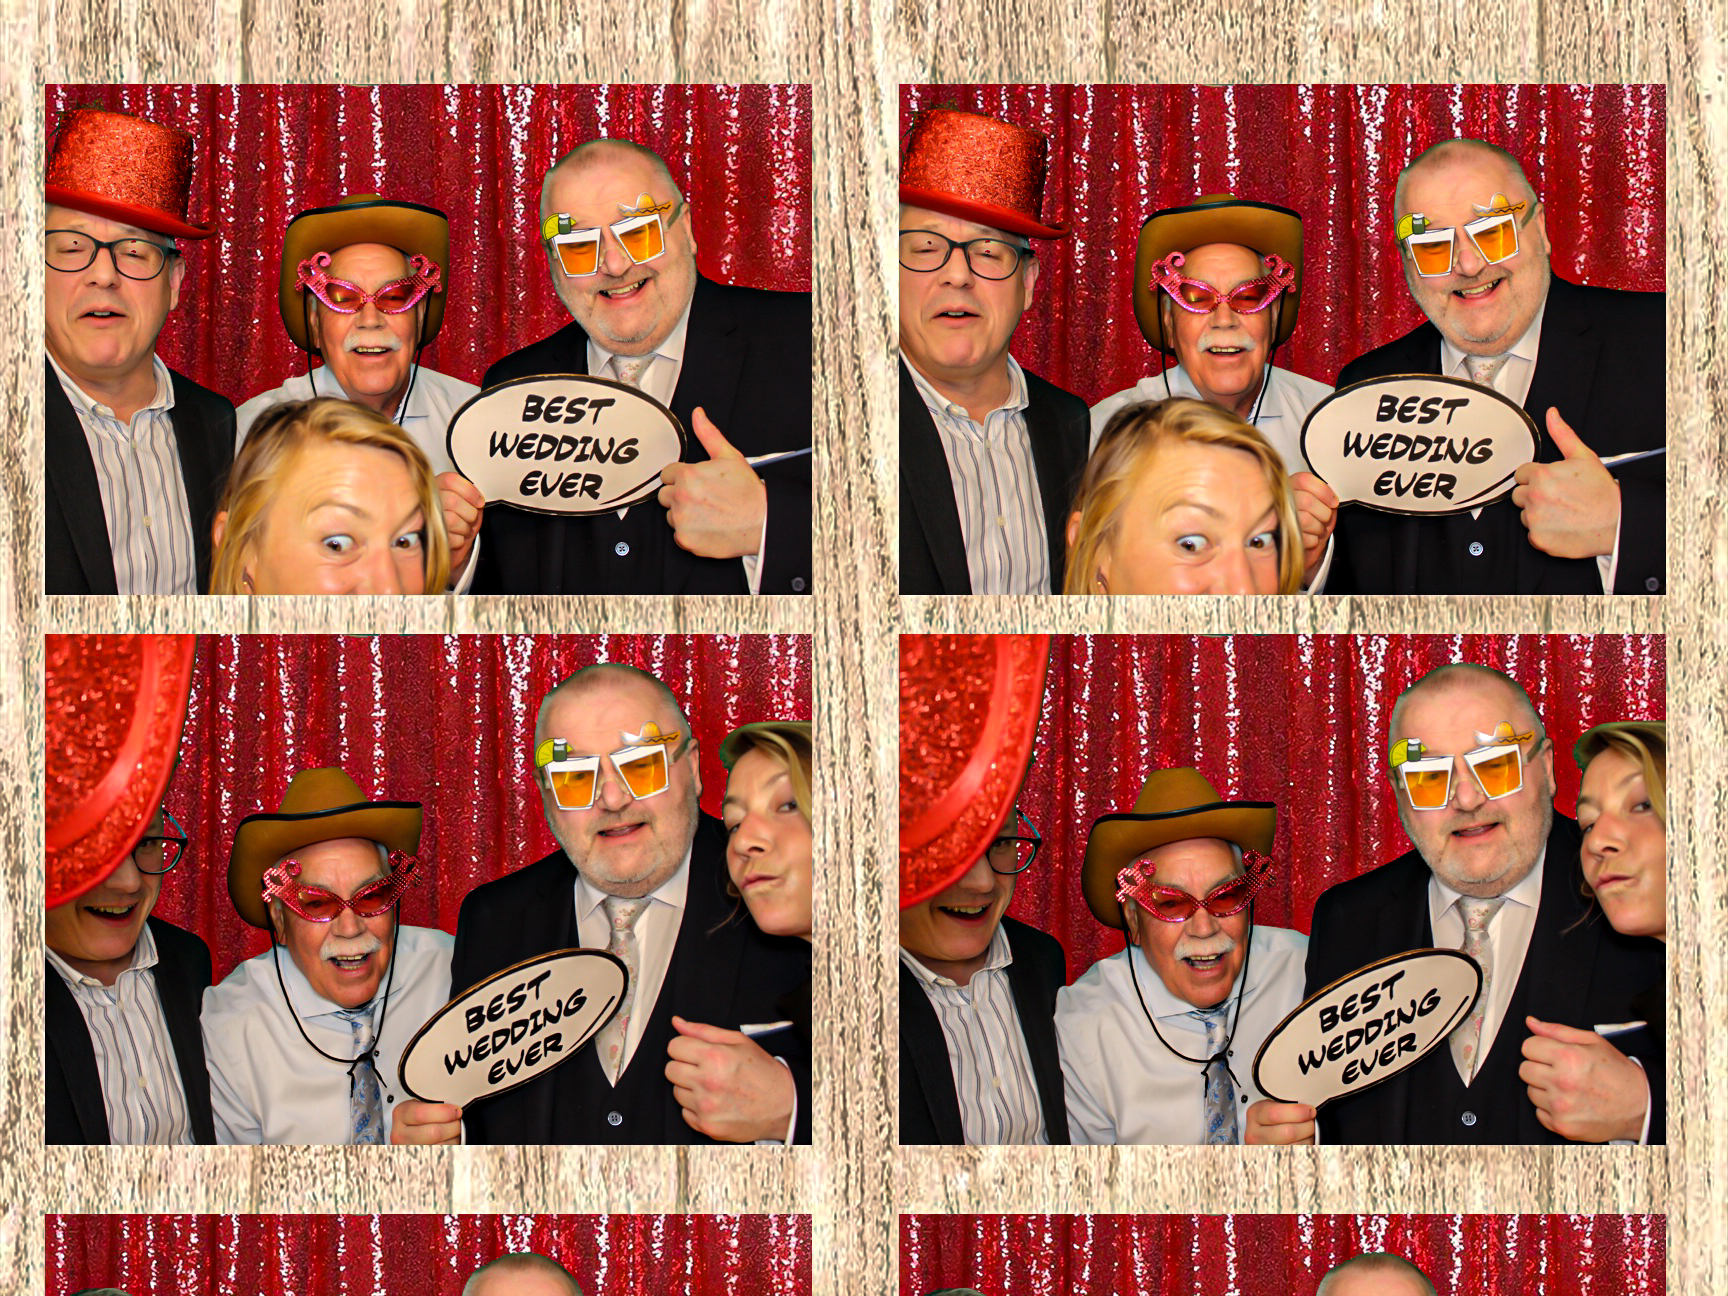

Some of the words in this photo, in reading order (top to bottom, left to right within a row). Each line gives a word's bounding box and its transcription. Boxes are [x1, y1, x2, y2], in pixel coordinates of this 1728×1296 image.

[522, 394, 616, 425] BEST
[1376, 394, 1470, 425] BEST
[489, 431, 640, 464] WEDDING
[1343, 431, 1494, 464] WEDDING
[519, 470, 604, 500] EVER
[1373, 470, 1458, 500] EVER
[465, 970, 551, 1033] BEST
[1319, 970, 1405, 1033] BEST
[444, 988, 588, 1075] WEDDING
[1298, 988, 1442, 1075] WEDDING
[488, 1033, 563, 1085] EVER
[1342, 1033, 1417, 1085] EVER
